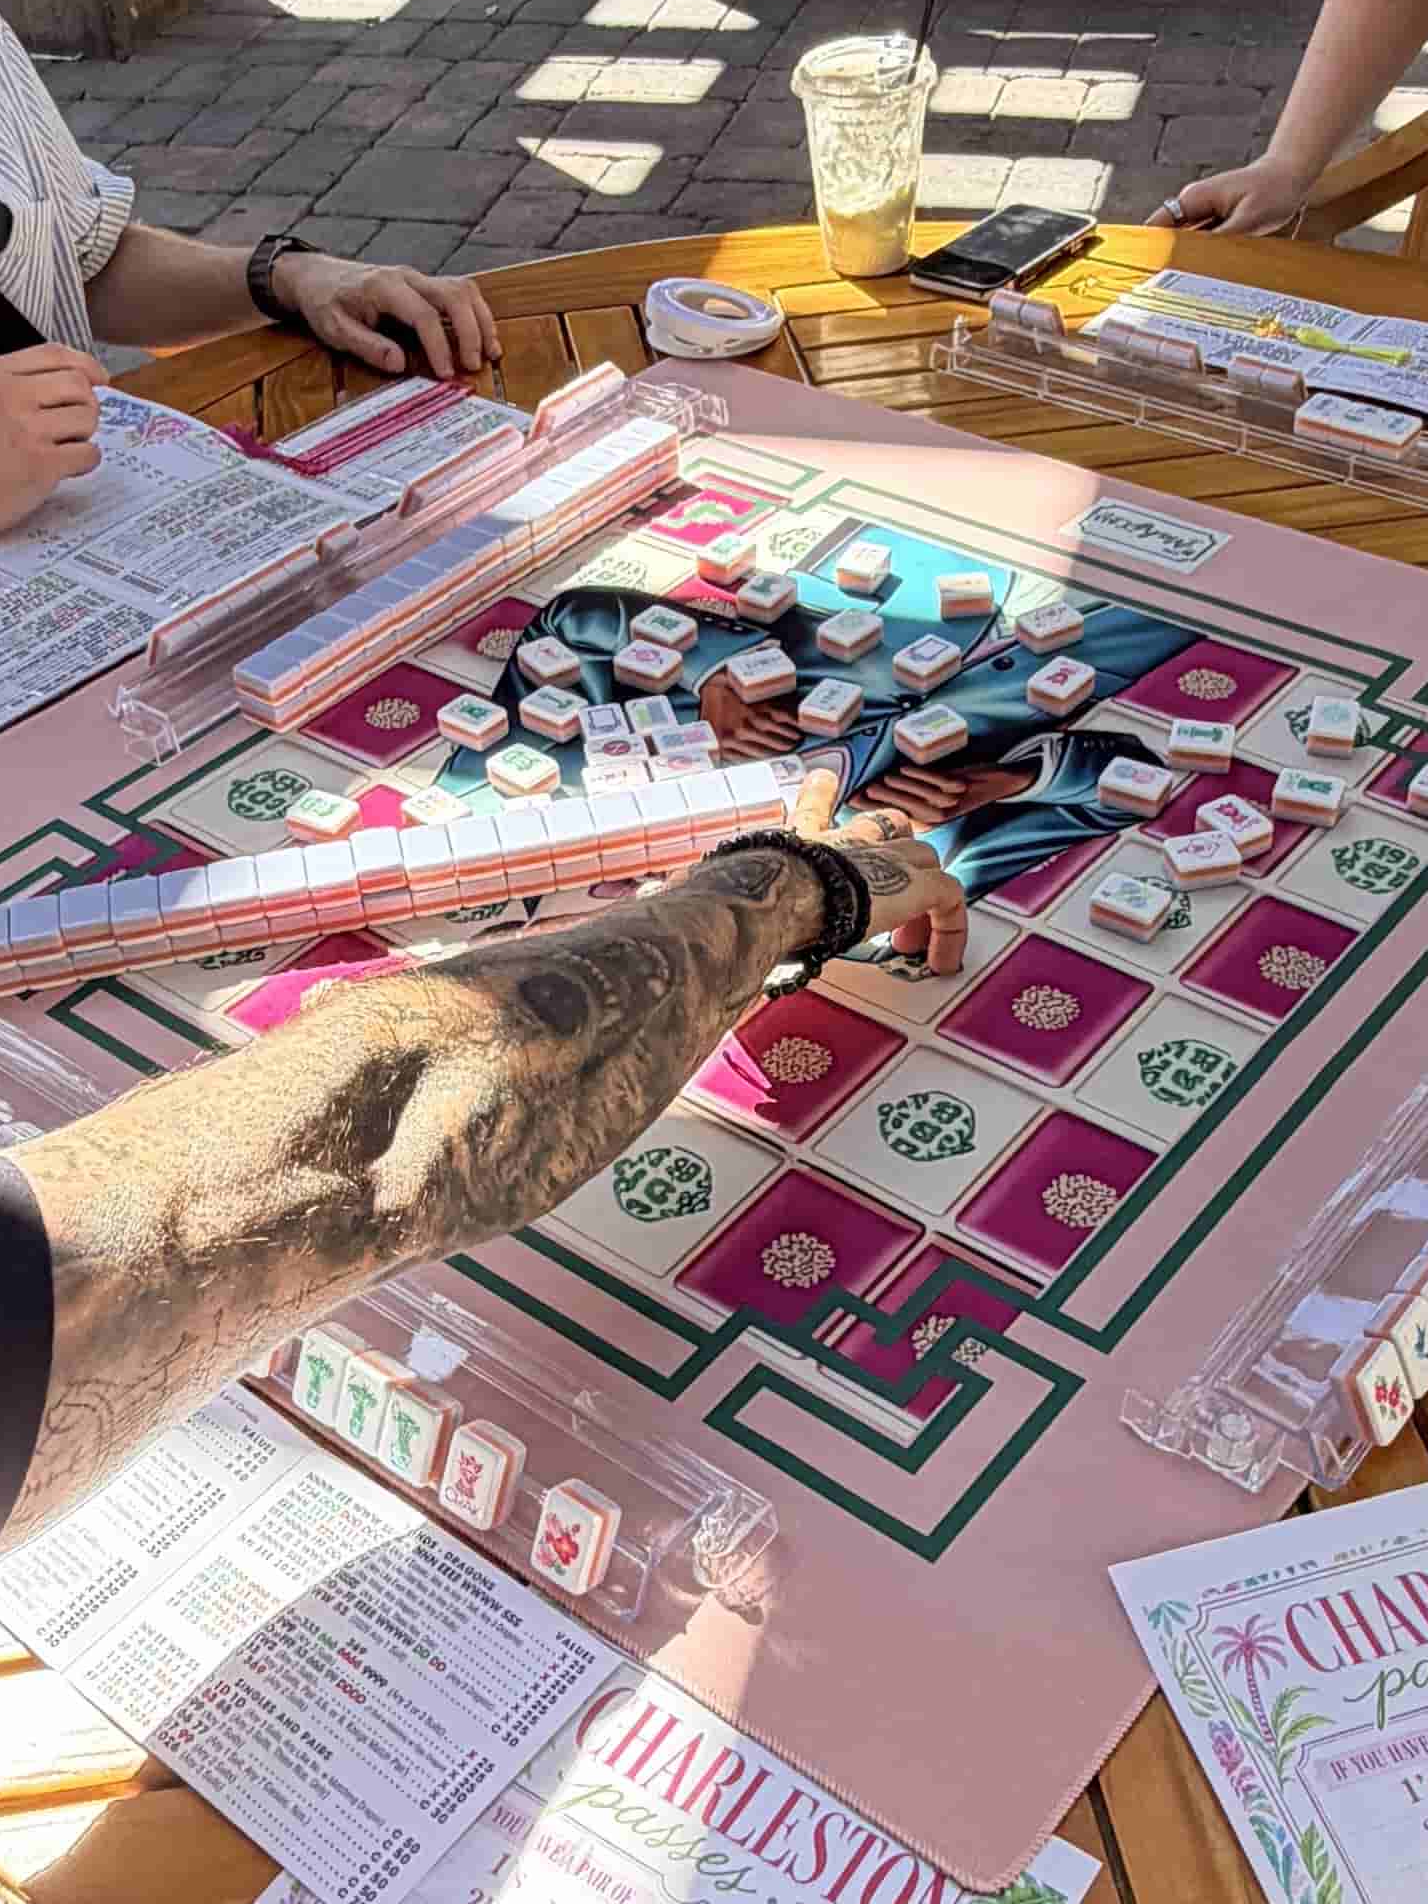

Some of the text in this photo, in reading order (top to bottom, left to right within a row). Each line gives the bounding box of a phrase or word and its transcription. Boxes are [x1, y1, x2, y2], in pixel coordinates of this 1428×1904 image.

[274, 1710, 301, 1735] AND
[1329, 1757, 1350, 1782] IF
[1348, 1747, 1390, 1776] YOU
[491, 1804, 523, 1836] YOU
[400, 1835, 422, 1856] 50
[545, 1783, 759, 1894] passes
[391, 1846, 412, 1867] 50
[379, 1858, 401, 1879] 50
[367, 1870, 389, 1891] 50
[356, 1883, 378, 1904] 50
